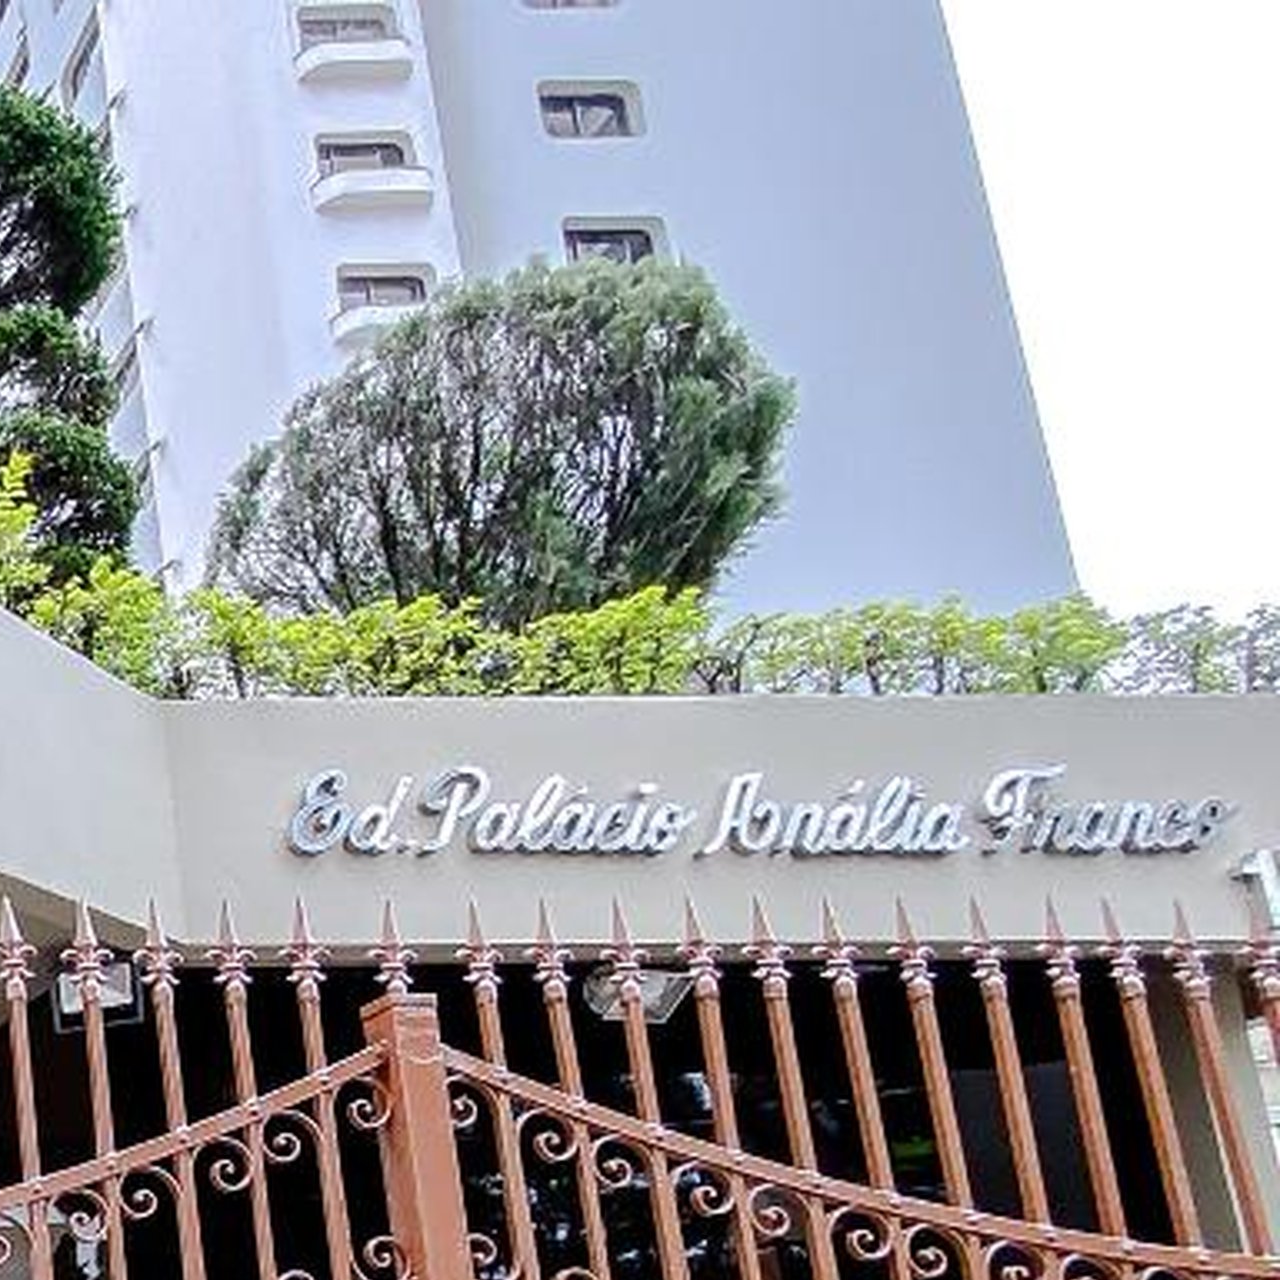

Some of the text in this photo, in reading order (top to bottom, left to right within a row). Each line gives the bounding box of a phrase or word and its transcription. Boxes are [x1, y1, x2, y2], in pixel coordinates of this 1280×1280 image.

[418, 765, 697, 855] Palácio
[694, 771, 971, 857] Anália
[981, 763, 1238, 855] Franco
